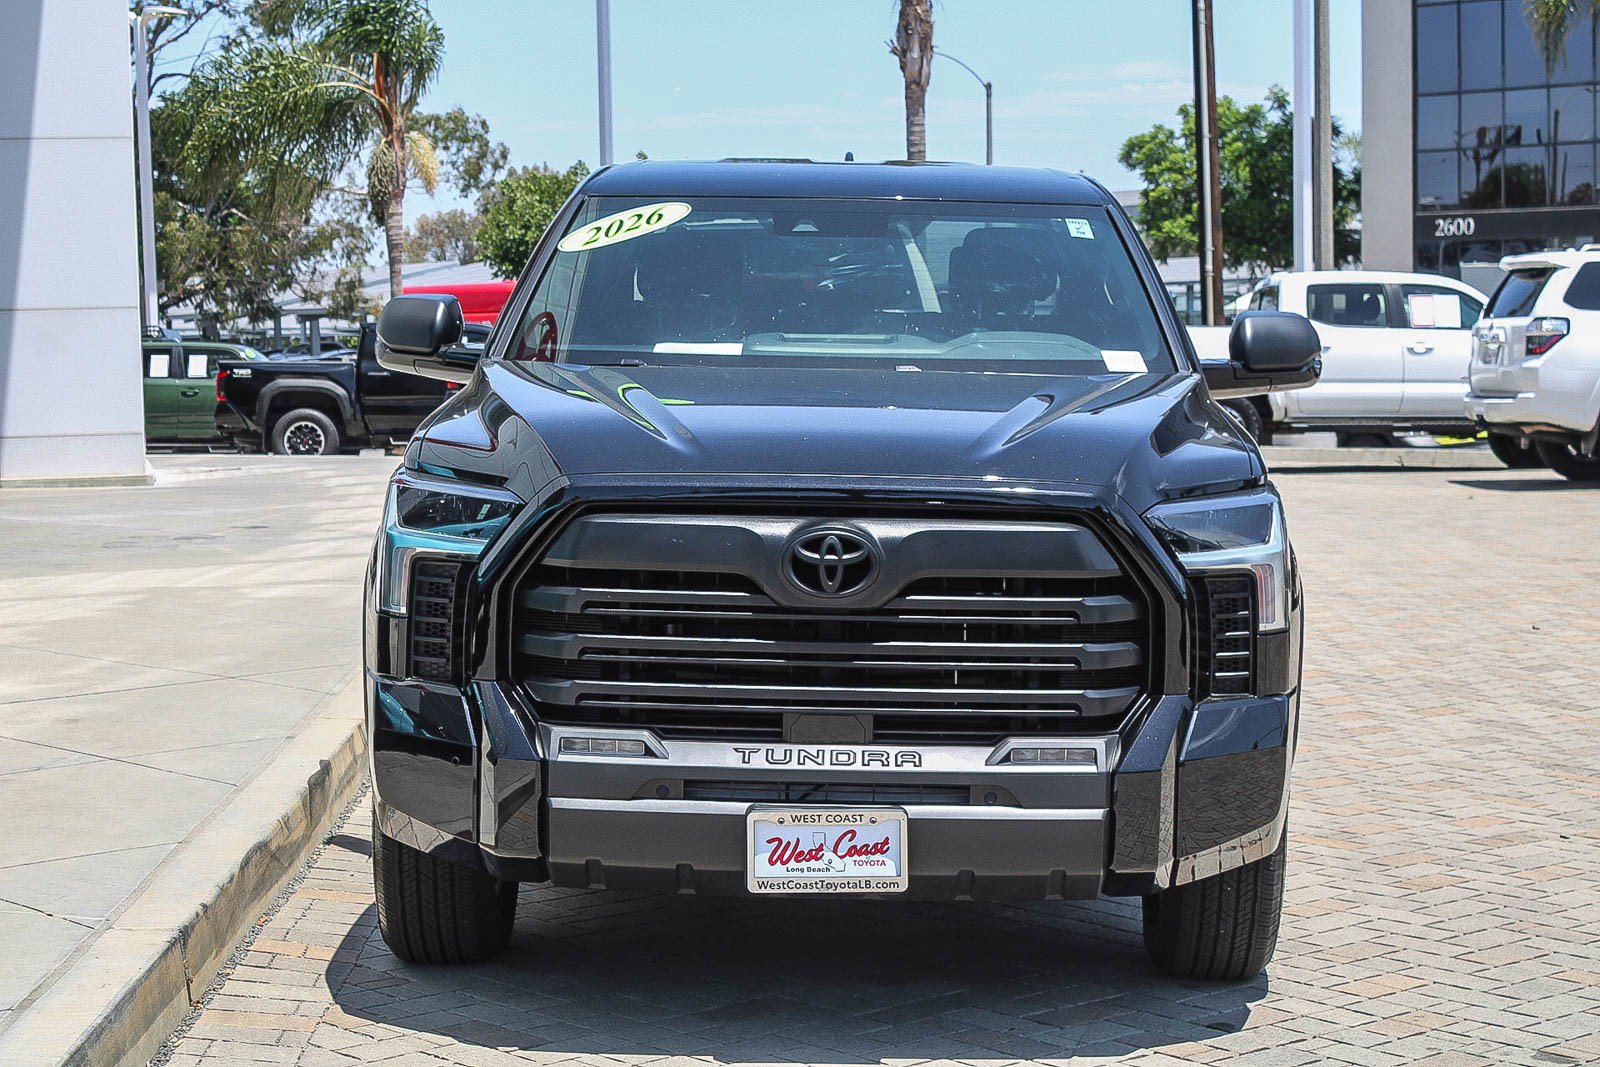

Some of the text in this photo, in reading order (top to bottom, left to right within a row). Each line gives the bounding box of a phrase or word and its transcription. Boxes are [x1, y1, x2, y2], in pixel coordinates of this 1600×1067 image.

[582, 206, 666, 246] 2026
[1434, 217, 1475, 236] 2600
[732, 747, 922, 768] TUNDRA
[790, 814, 864, 824] WEST COAST
[766, 829, 891, 867] West Coast
[853, 859, 887, 867] TOYOTA
[757, 880, 900, 892] WestCoastToyotaLB.com
